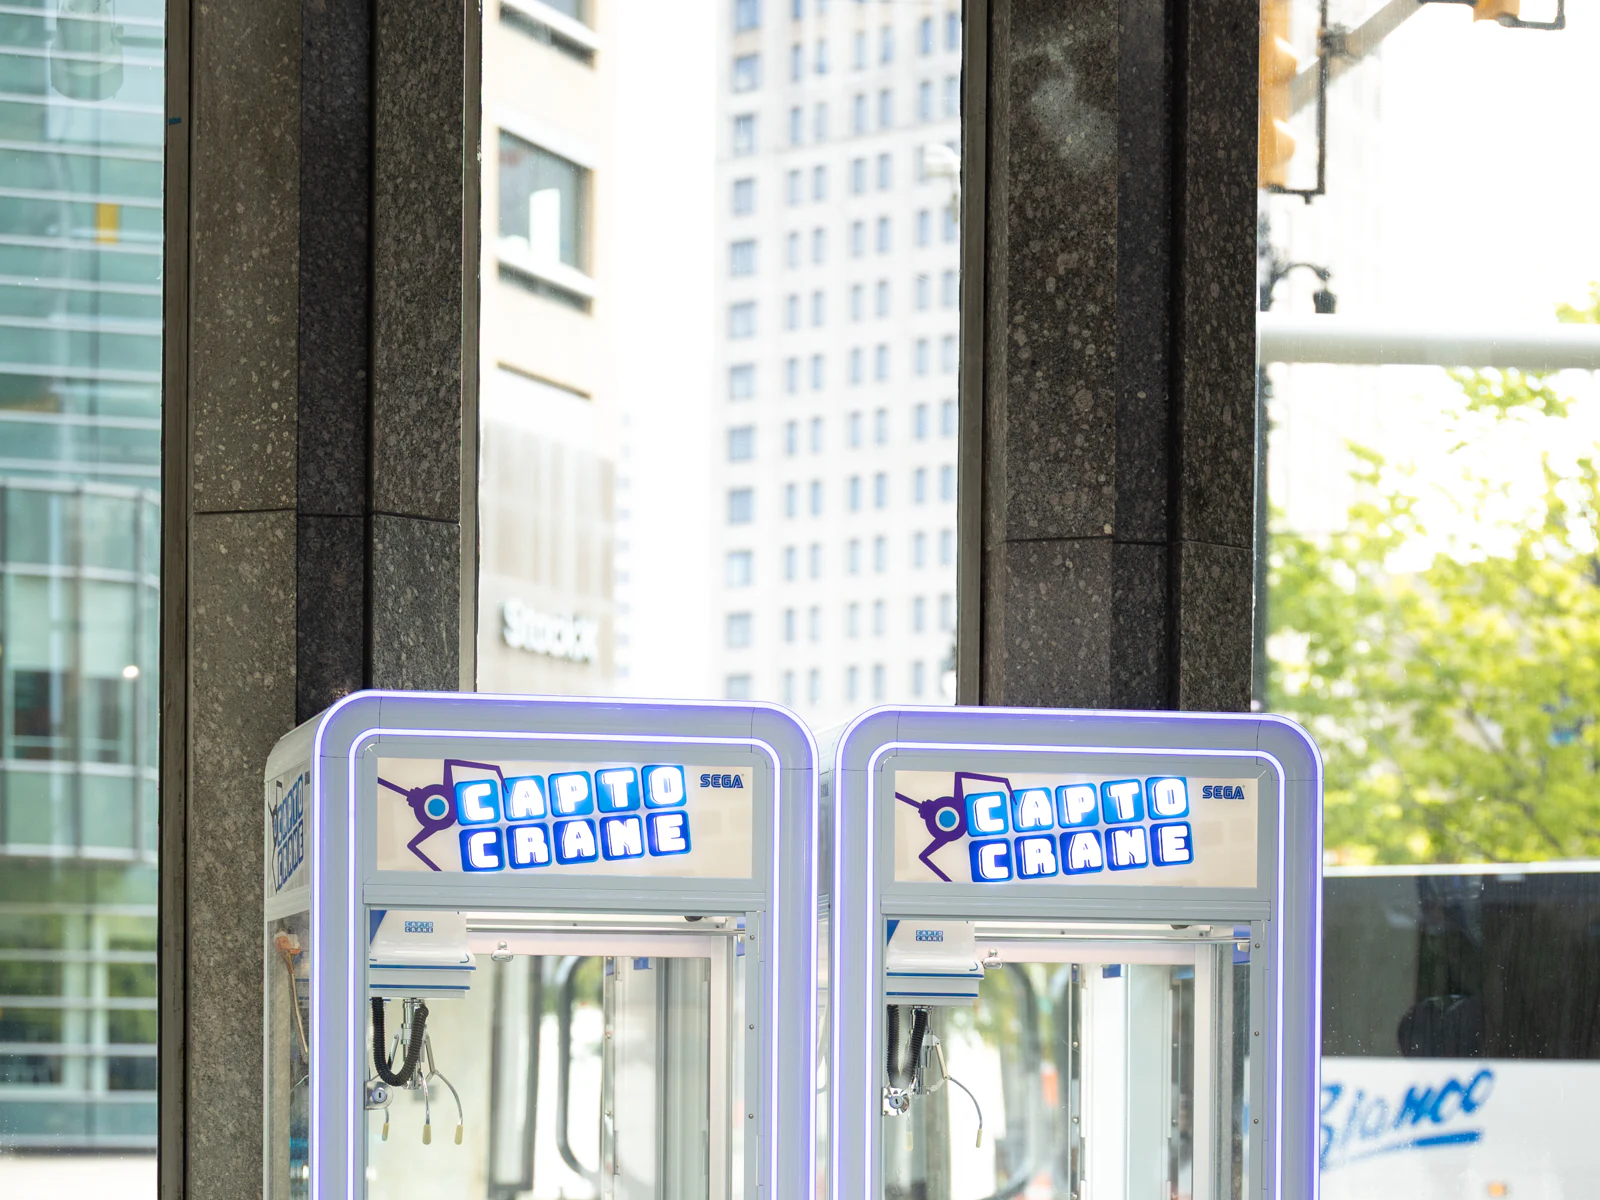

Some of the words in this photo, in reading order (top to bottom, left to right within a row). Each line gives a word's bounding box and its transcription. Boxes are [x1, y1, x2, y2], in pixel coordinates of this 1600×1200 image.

[464, 766, 685, 823] CAPTO
[700, 774, 744, 788] SEGA
[973, 777, 1187, 832] CAPTO
[1202, 785, 1245, 799] SEGA
[467, 813, 687, 869] CRANE
[977, 823, 1190, 880] CRANE
